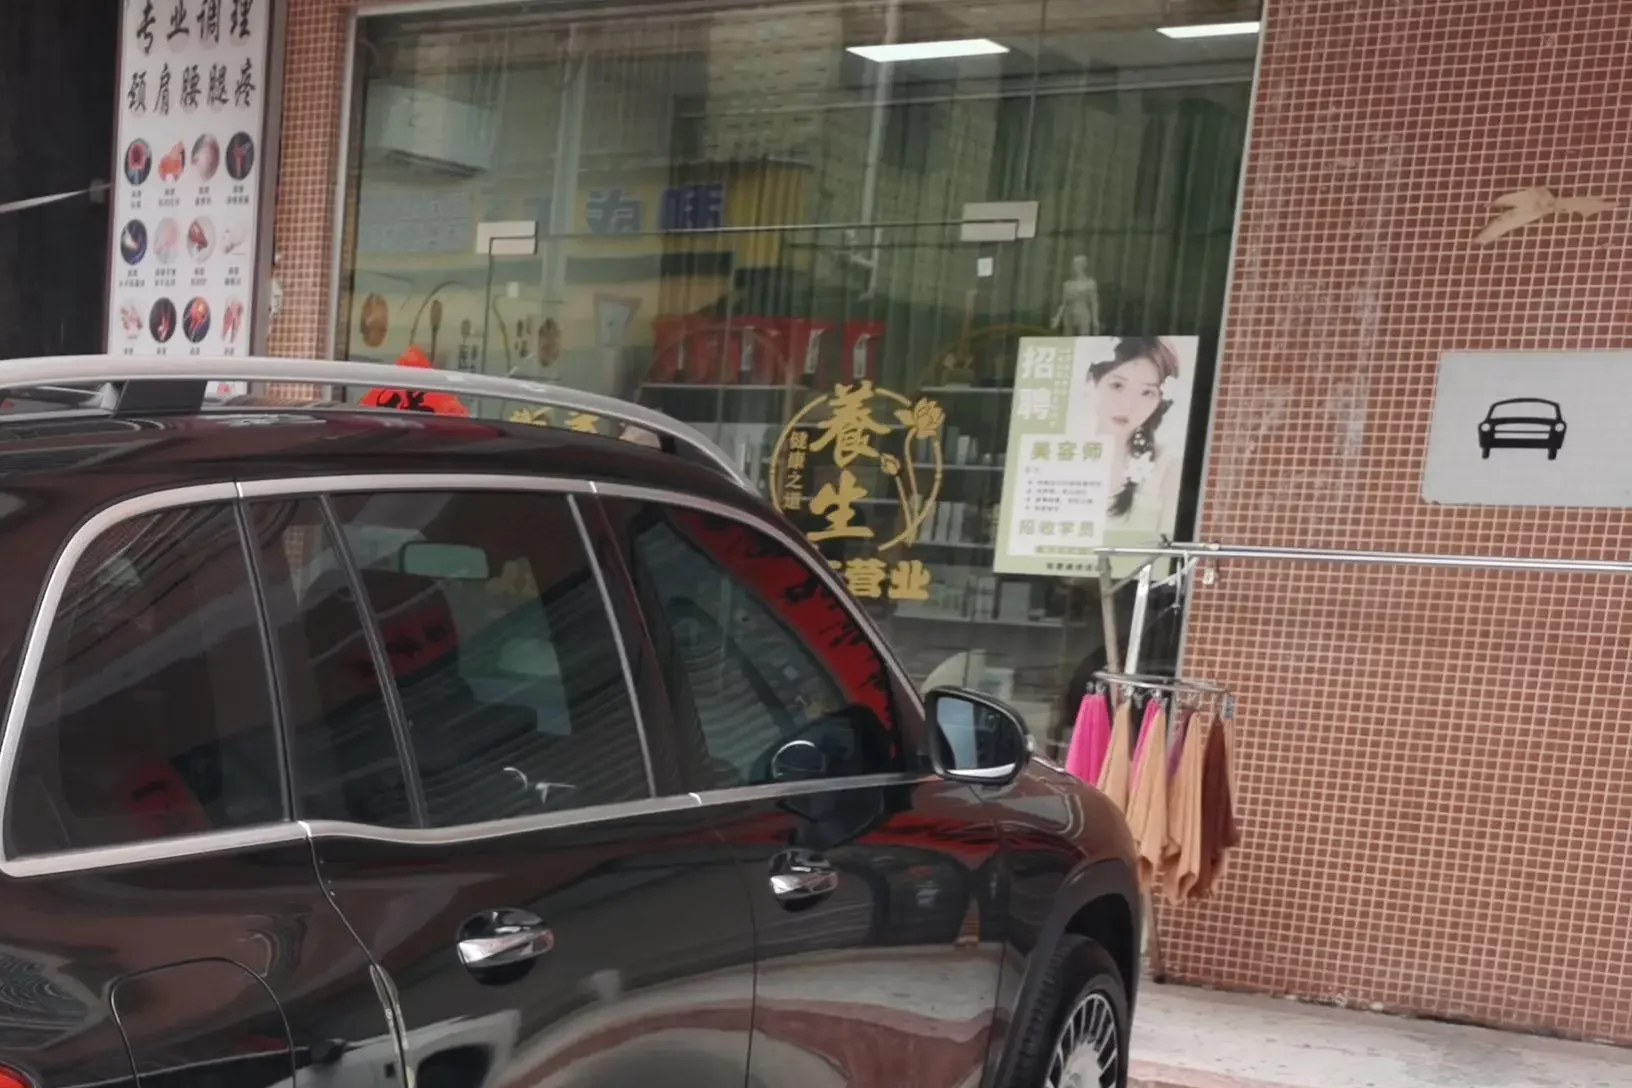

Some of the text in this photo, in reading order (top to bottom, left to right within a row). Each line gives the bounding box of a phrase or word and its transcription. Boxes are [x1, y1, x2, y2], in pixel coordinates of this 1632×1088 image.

[1018, 347, 1056, 420] 招聘
[1030, 440, 1103, 461] 美容师
[827, 558, 931, 600] 营业
